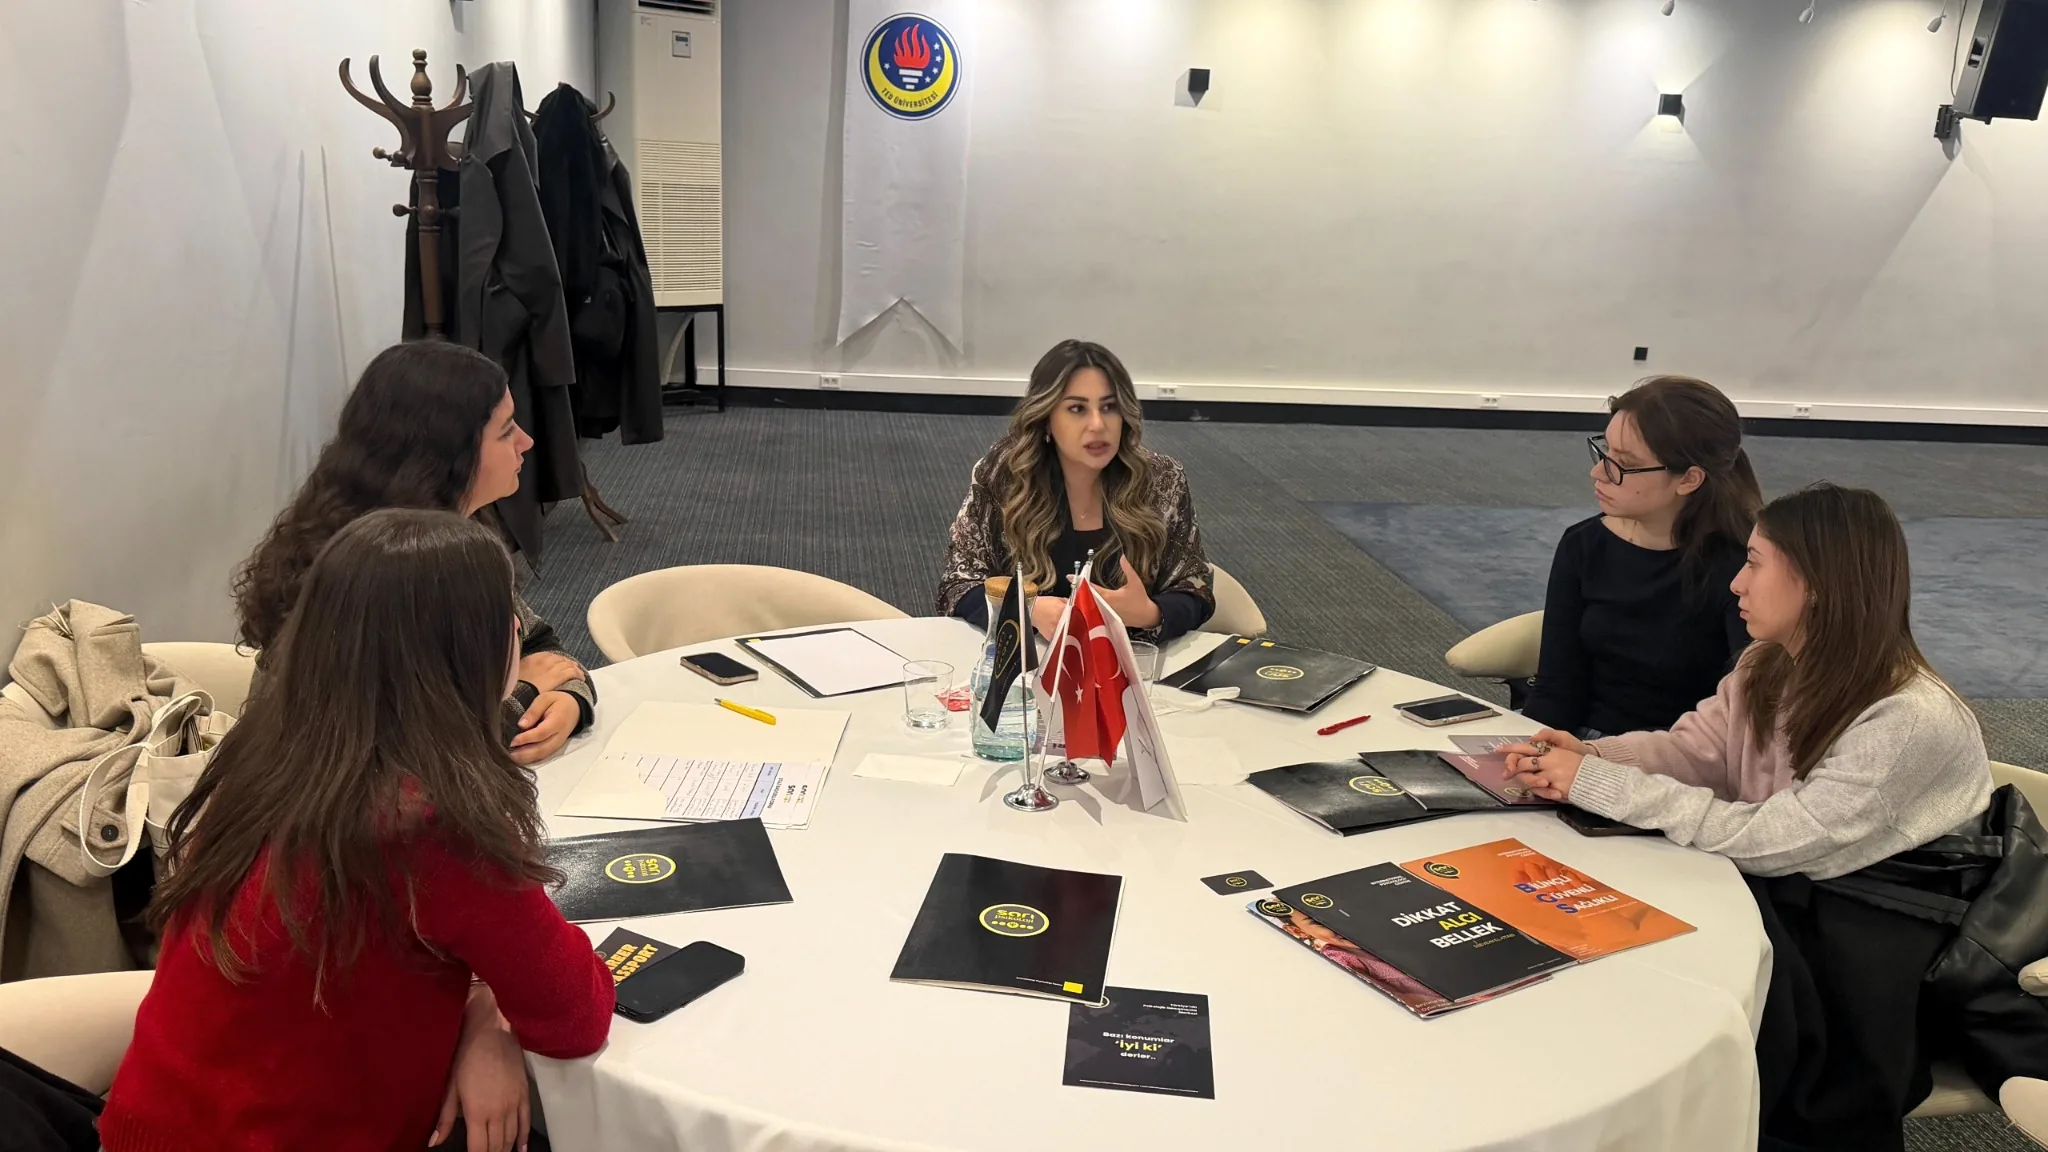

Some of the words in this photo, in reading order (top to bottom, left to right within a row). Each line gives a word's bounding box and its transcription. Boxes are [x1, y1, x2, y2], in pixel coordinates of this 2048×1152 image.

[881, 87, 894, 100] TED
[893, 90, 939, 108] ÜNİVERSİTESİ
[1391, 901, 1462, 927] DİKKAT
[1438, 912, 1483, 931] ALGI
[1429, 921, 1504, 948] BELLEK
[612, 943, 659, 983] ASSPORT
[1102, 1031, 1124, 1039] Bazı
[1125, 1033, 1175, 1044] konumlar
